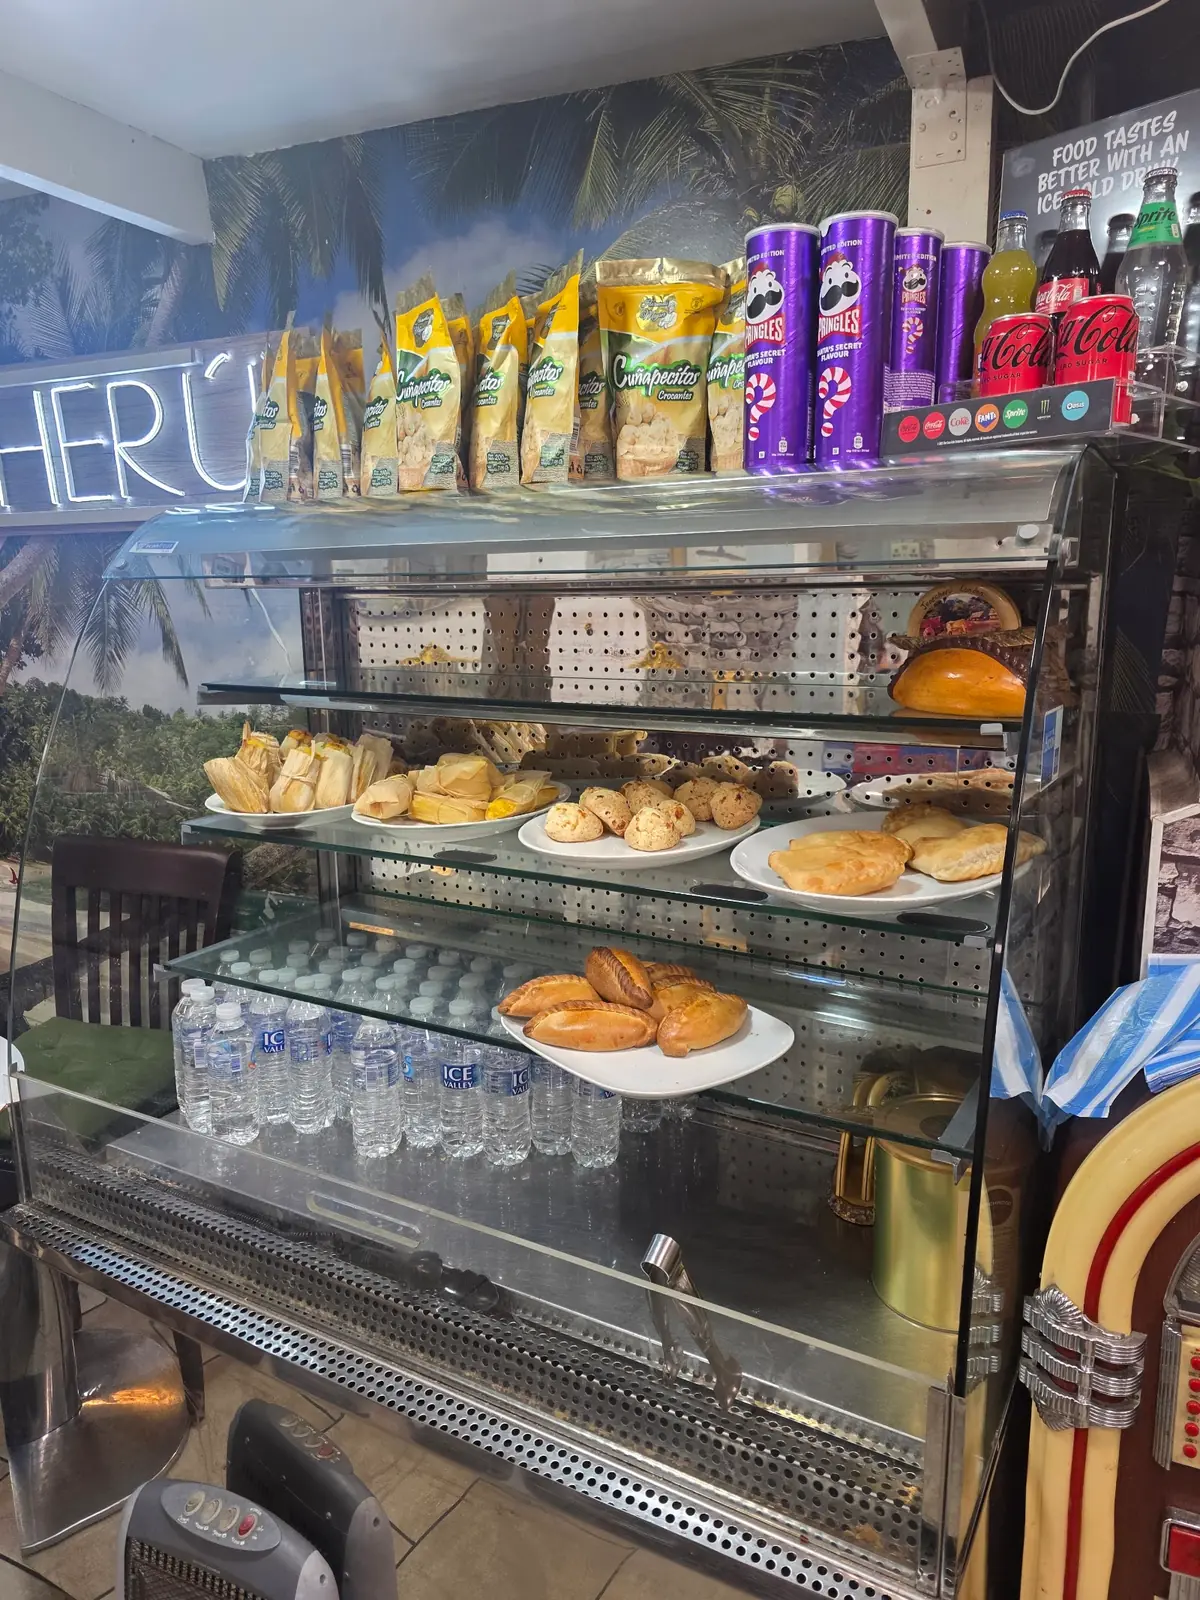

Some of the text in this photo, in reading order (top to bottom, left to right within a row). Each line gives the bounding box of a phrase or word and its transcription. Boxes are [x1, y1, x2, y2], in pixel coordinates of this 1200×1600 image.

[1052, 110, 1178, 168] FOOD TASTES
[1038, 130, 1189, 194] BETTER WITH AN
[1037, 191, 1063, 215] ICE
[837, 239, 863, 249] EDITION
[818, 308, 860, 342] PRINGLES
[835, 342, 863, 351] SECRET
[760, 349, 786, 358] SECRET
[820, 350, 849, 362] FLAVOUR
[747, 357, 774, 369] FLAVOUR
[1075, 357, 1108, 367] SUGAR
[613, 364, 701, 397] Cuñapecitos
[993, 372, 1022, 381] SUGAR
[657, 390, 693, 401] Crocantes
[1067, 402, 1085, 410] Oasis
[1005, 408, 1026, 419] Sprite
[950, 415, 969, 428] Coke
[444, 1065, 472, 1081] ICE
[443, 1080, 473, 1090] VALLEY
